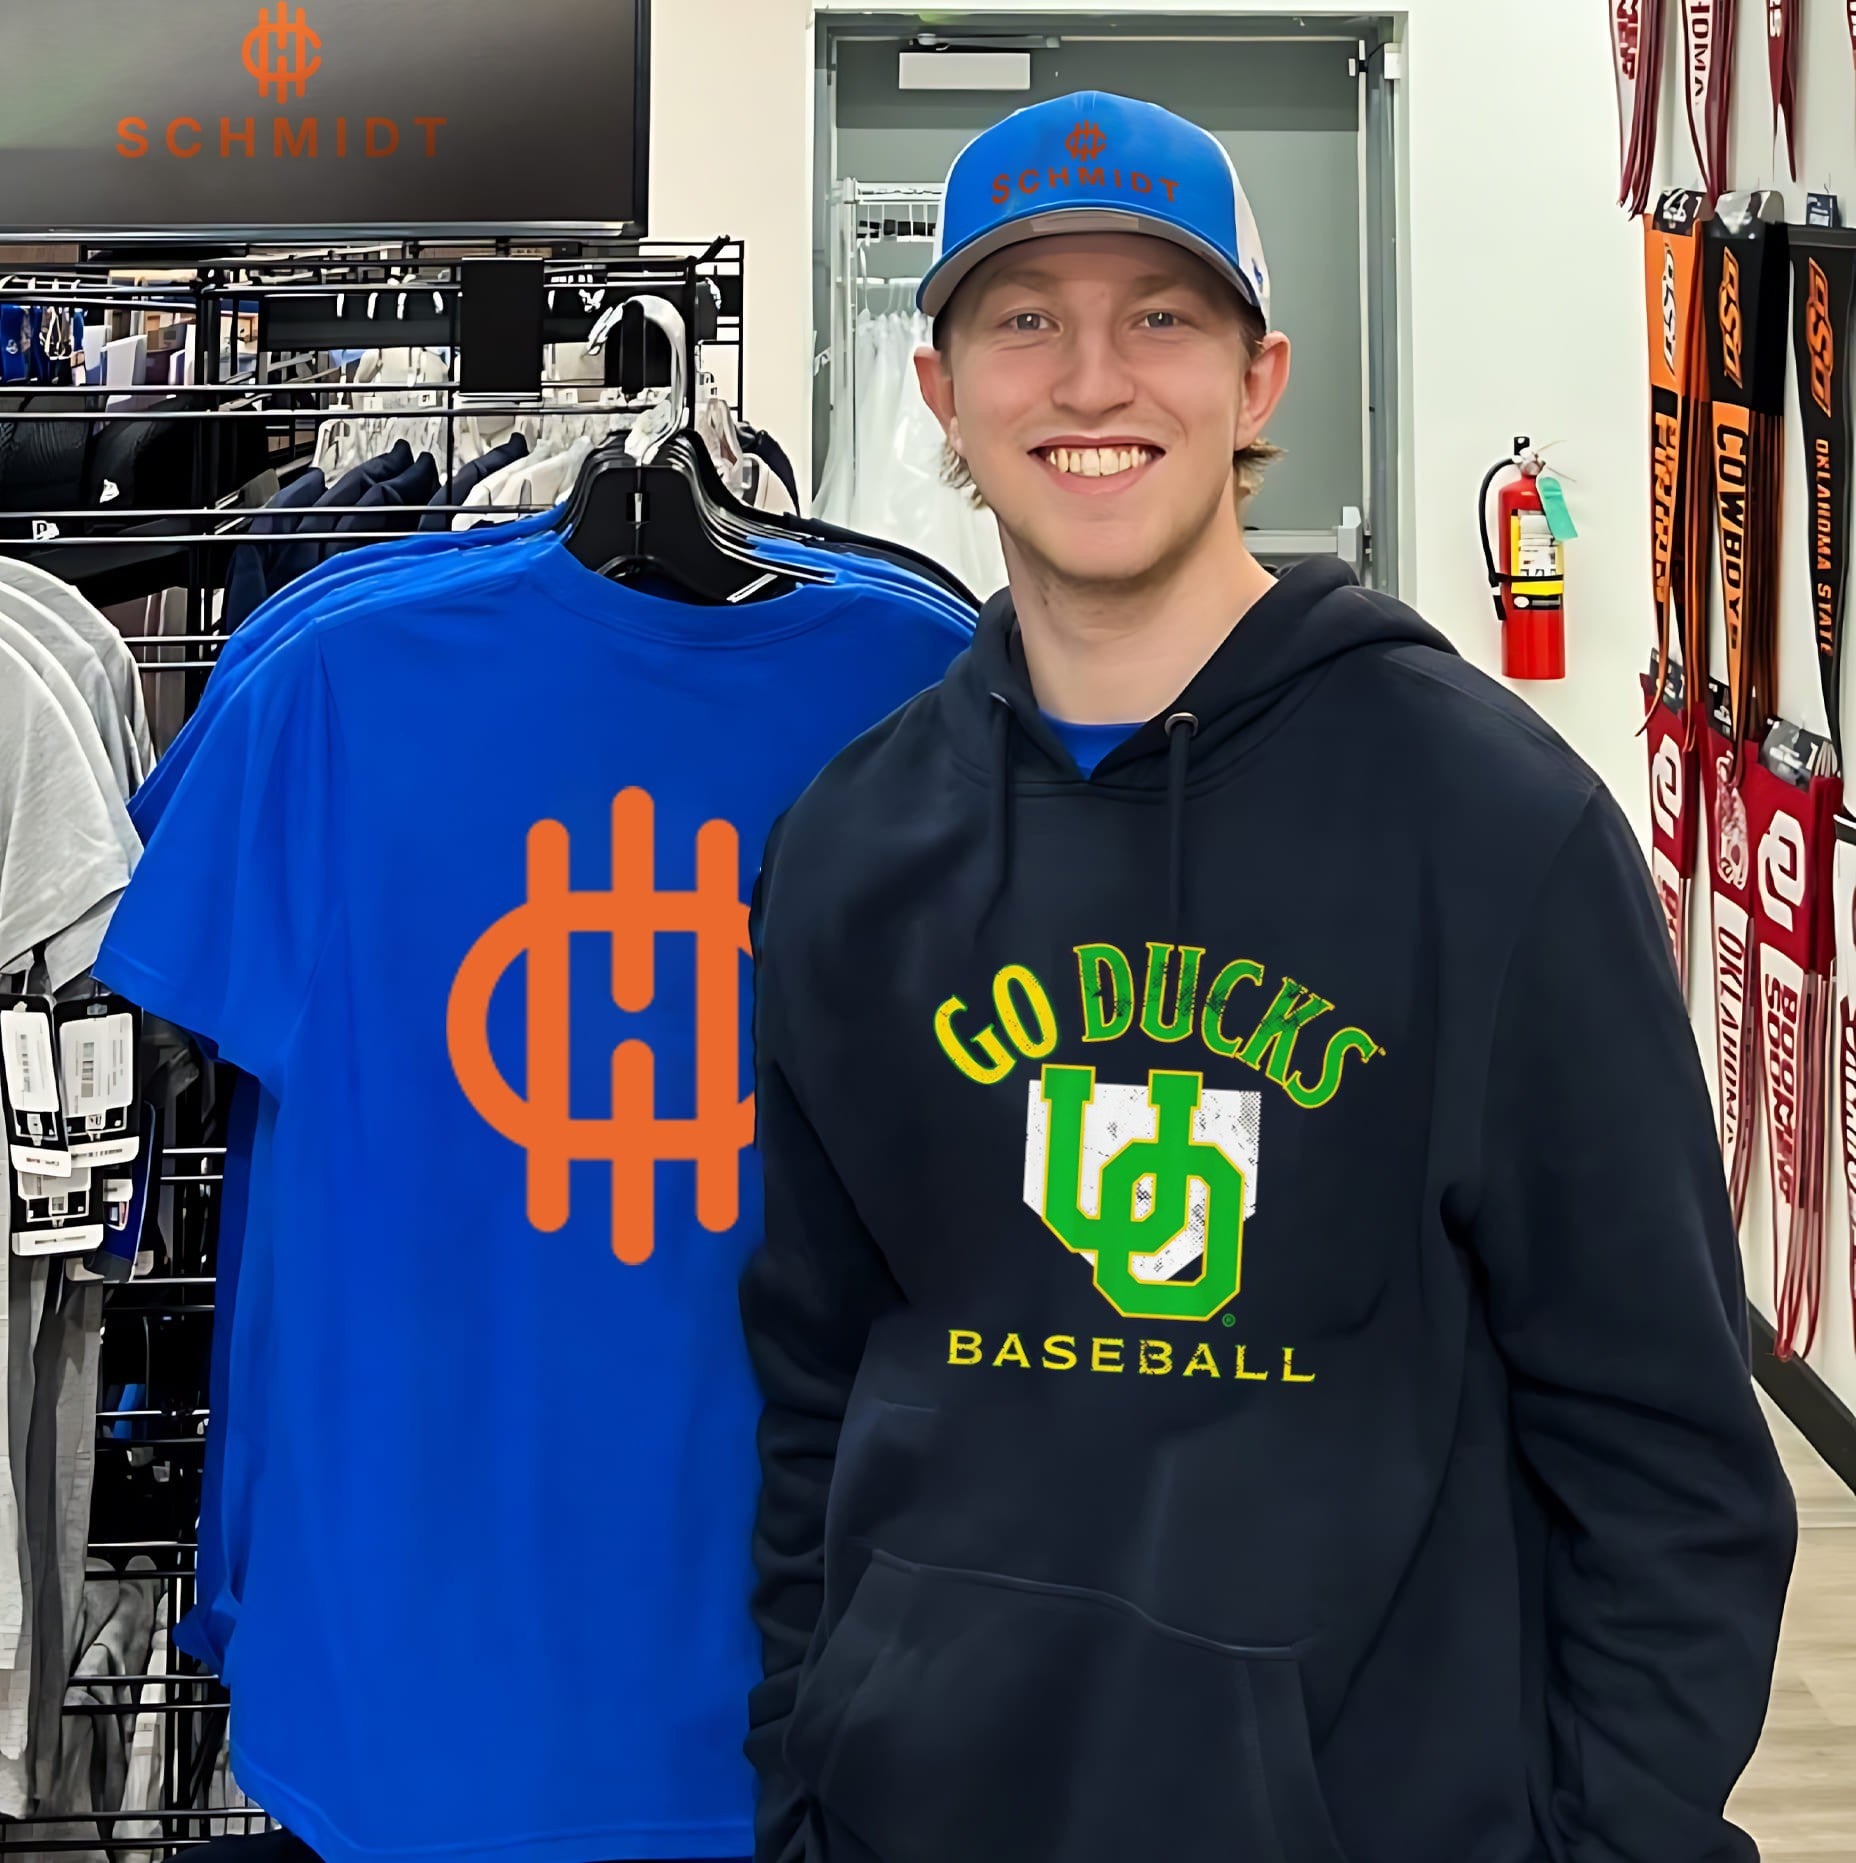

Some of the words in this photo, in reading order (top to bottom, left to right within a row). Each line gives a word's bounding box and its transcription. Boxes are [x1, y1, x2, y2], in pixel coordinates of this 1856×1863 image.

[115, 116, 447, 159] SCHMIDT
[991, 167, 1179, 204] SCHMIDT
[1815, 439, 1832, 570] OKLAHOMA
[933, 964, 1058, 1085] GO
[1073, 941, 1379, 1109] DUCKS
[946, 1329, 1316, 1382] BASEBALL
